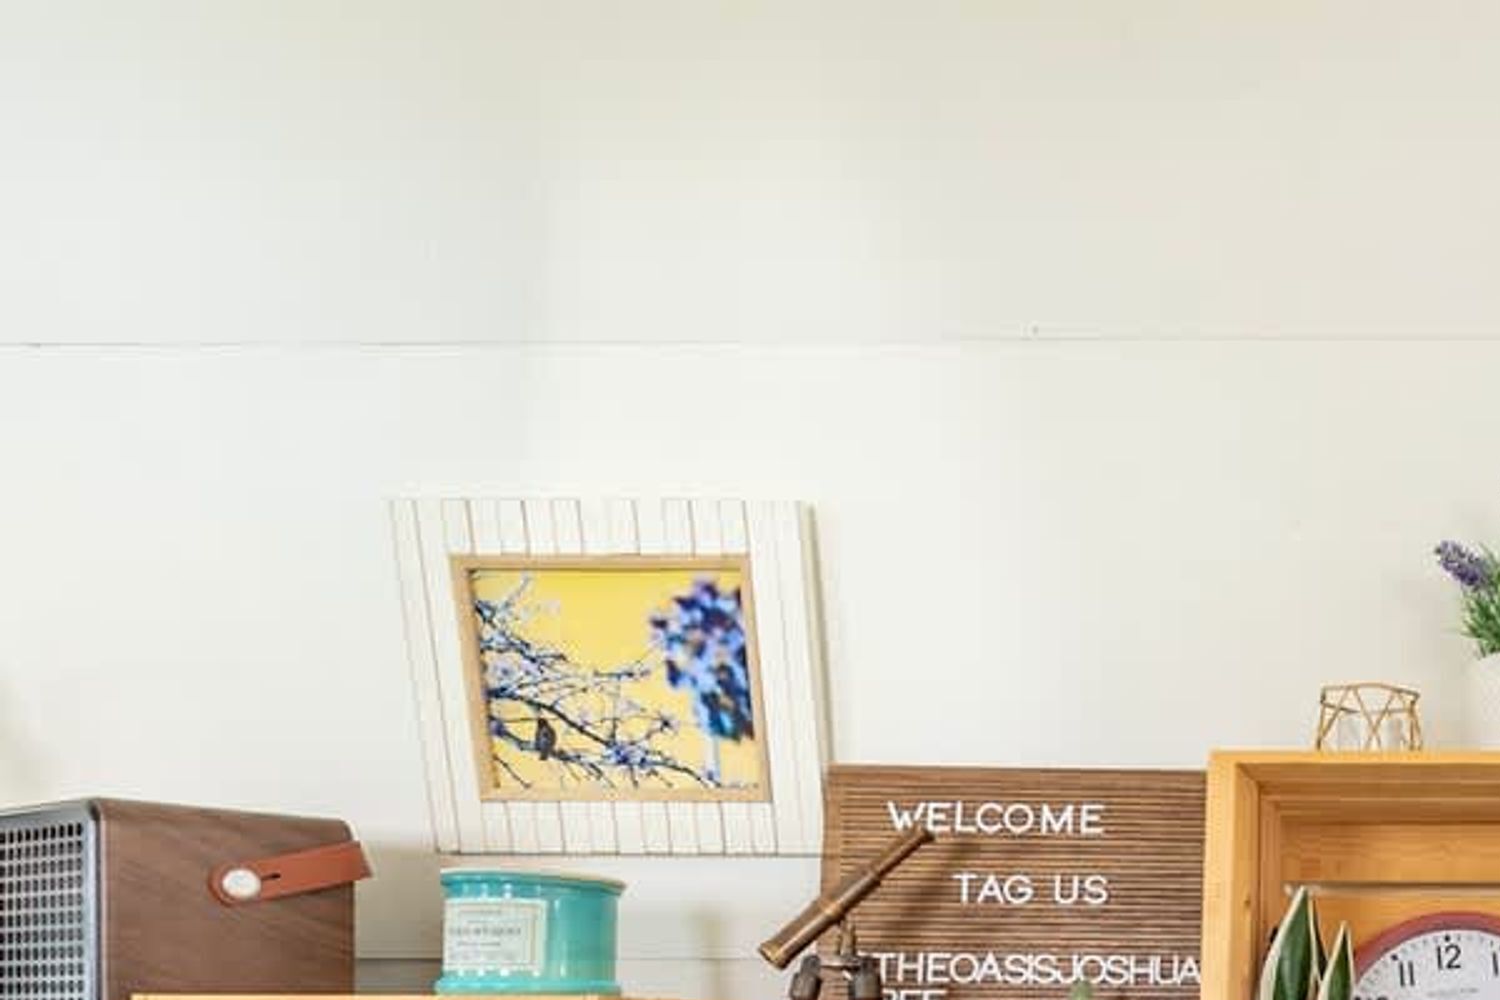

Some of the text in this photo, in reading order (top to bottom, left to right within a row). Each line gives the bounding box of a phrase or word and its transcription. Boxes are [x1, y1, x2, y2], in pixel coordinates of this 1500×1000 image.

[886, 800, 1105, 835] WELCOME
[952, 872, 1109, 905] TAG US
[843, 950, 1201, 985] THEOASISJOSHUA
[1437, 944, 1462, 970] 12
[1399, 961, 1415, 987] 11
